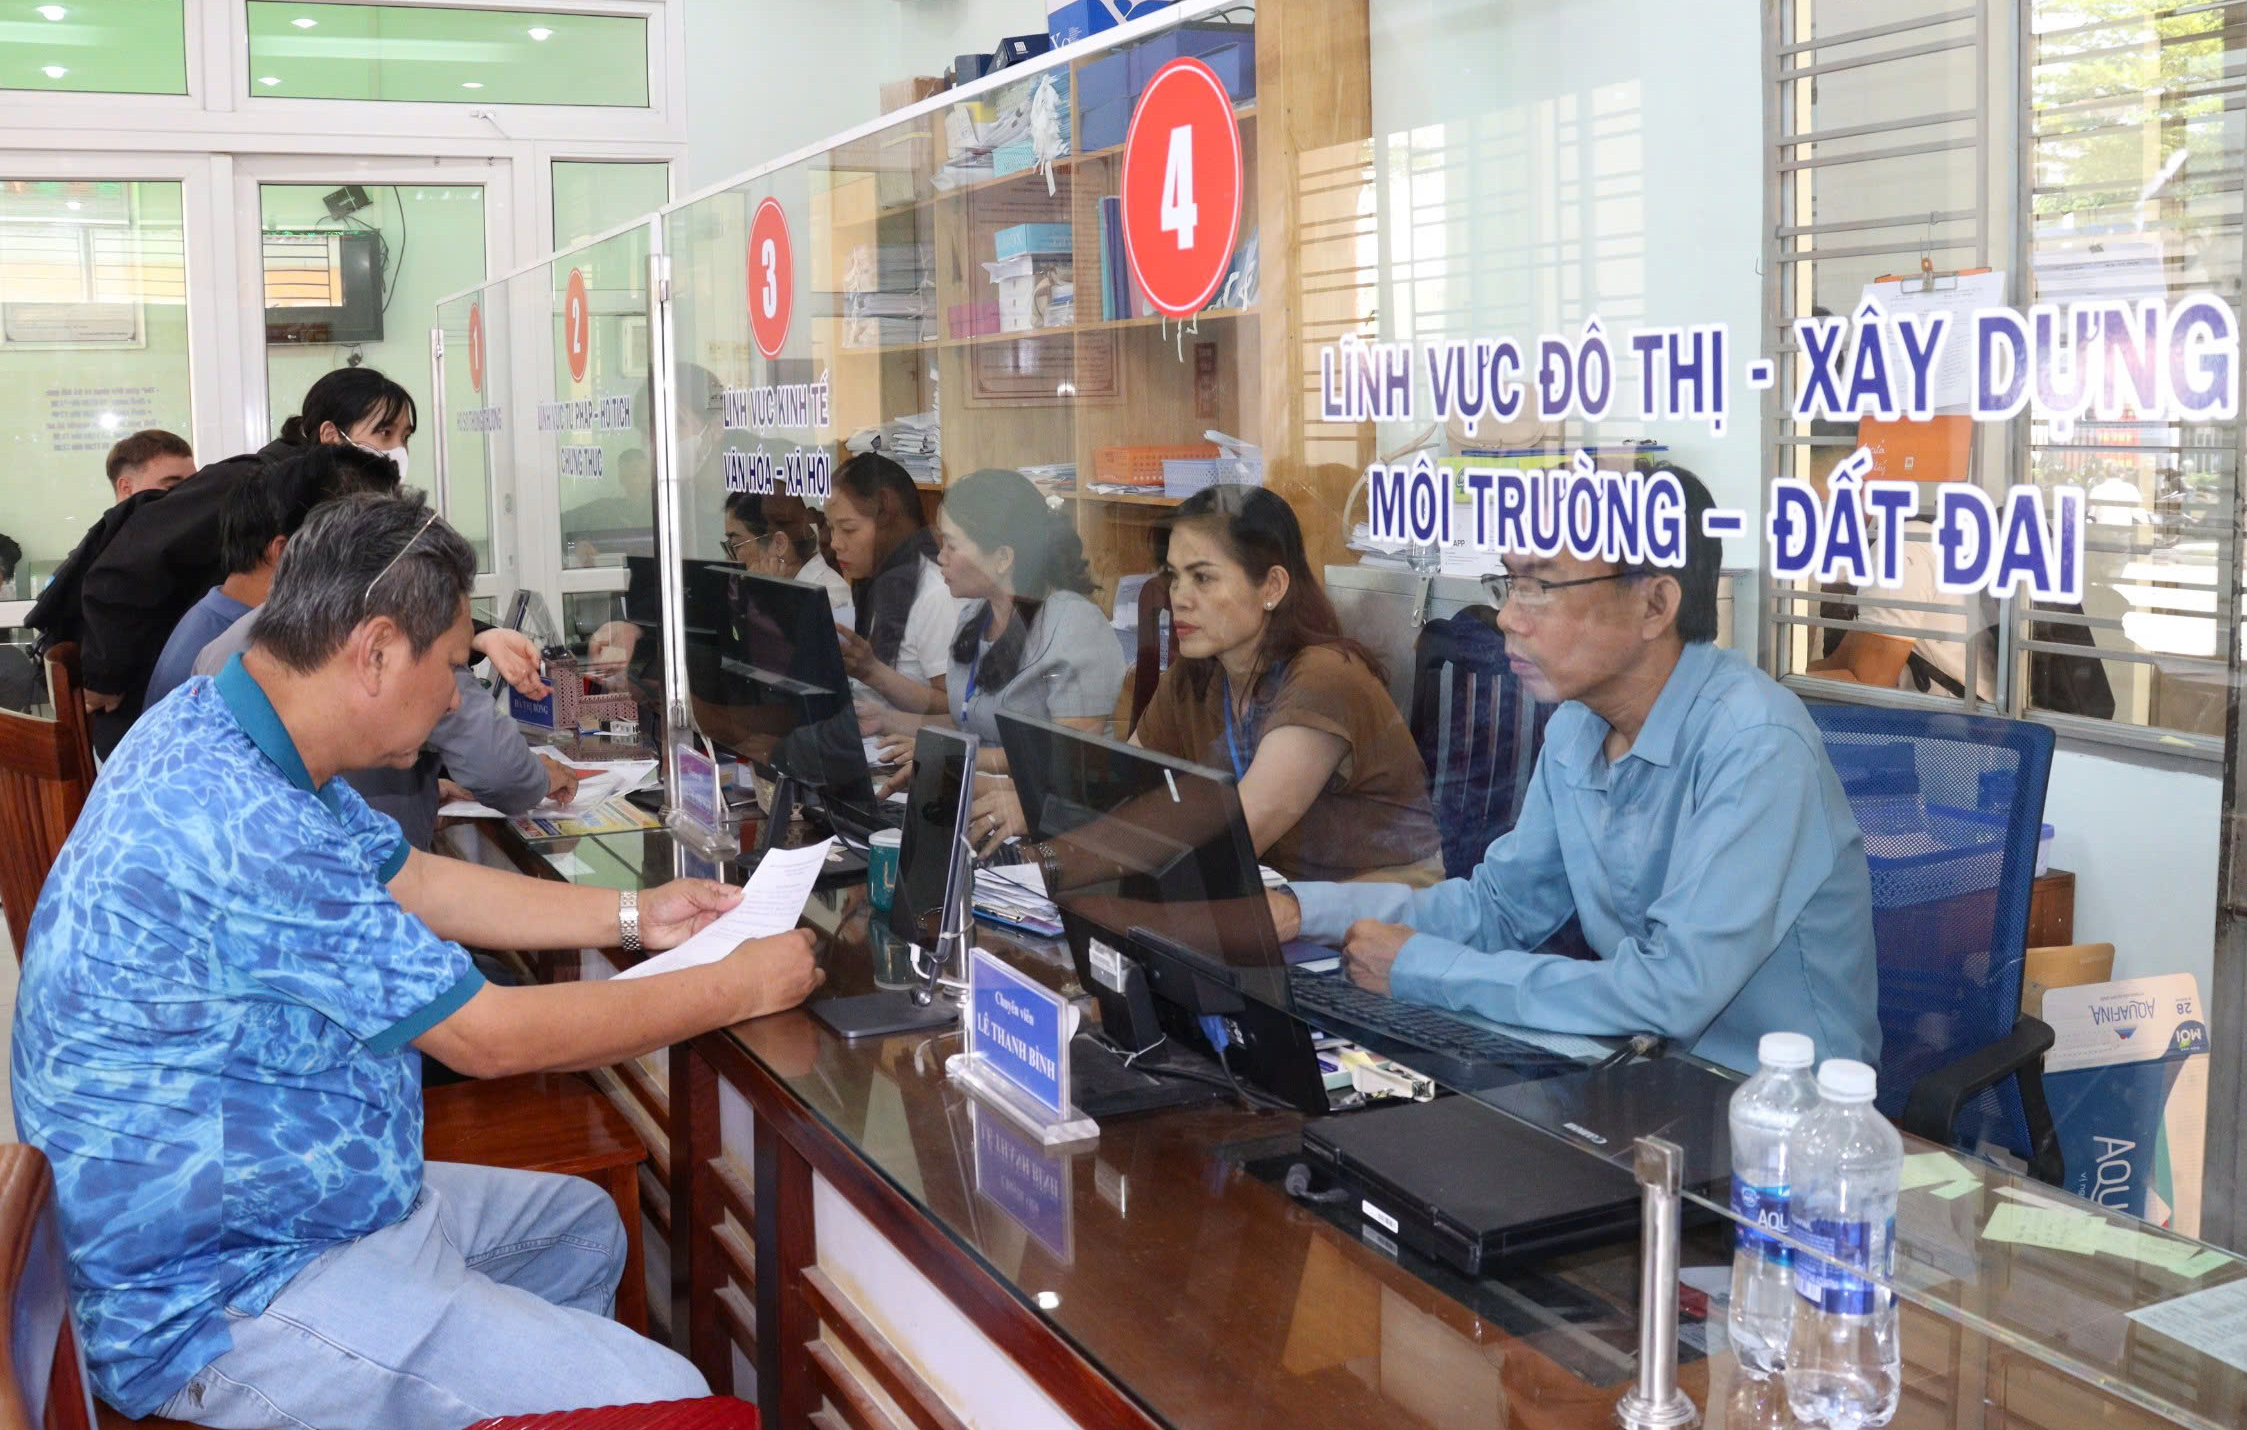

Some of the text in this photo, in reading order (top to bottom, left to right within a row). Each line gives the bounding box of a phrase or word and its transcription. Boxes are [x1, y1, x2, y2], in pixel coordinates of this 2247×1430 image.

[1161, 123, 1198, 251] 4
[760, 238, 778, 320] 3
[472, 331, 480, 371] 1
[570, 298, 582, 355] 2
[1322, 336, 1411, 418] LĨNH
[1426, 342, 1522, 432] VỰC
[1537, 321, 1612, 417] ĐÔ
[1632, 329, 1725, 431] THỊ
[1798, 303, 1947, 414] XÂY
[1975, 302, 2231, 433] DỰNG
[776, 385, 808, 427] KINH
[811, 370, 829, 427] TẾ
[723, 447, 746, 492] VĂN
[748, 445, 774, 494] HÓA
[806, 447, 831, 504] HỘI
[1371, 457, 1451, 543] MÔI
[1467, 457, 1682, 561] TRƯỜNG
[1770, 457, 1913, 582] ĐẤT
[1937, 491, 2076, 595] ĐAI
[994, 991, 1035, 1026] Chuyên viên
[2088, 997, 2156, 1026] AQUAFINA
[2176, 1001, 2192, 1015] 28
[977, 1011, 1056, 1082] LÊ THANH BÌNH
[2078, 1183, 2087, 1199] ng
[2091, 1135, 2136, 1209] AQU
